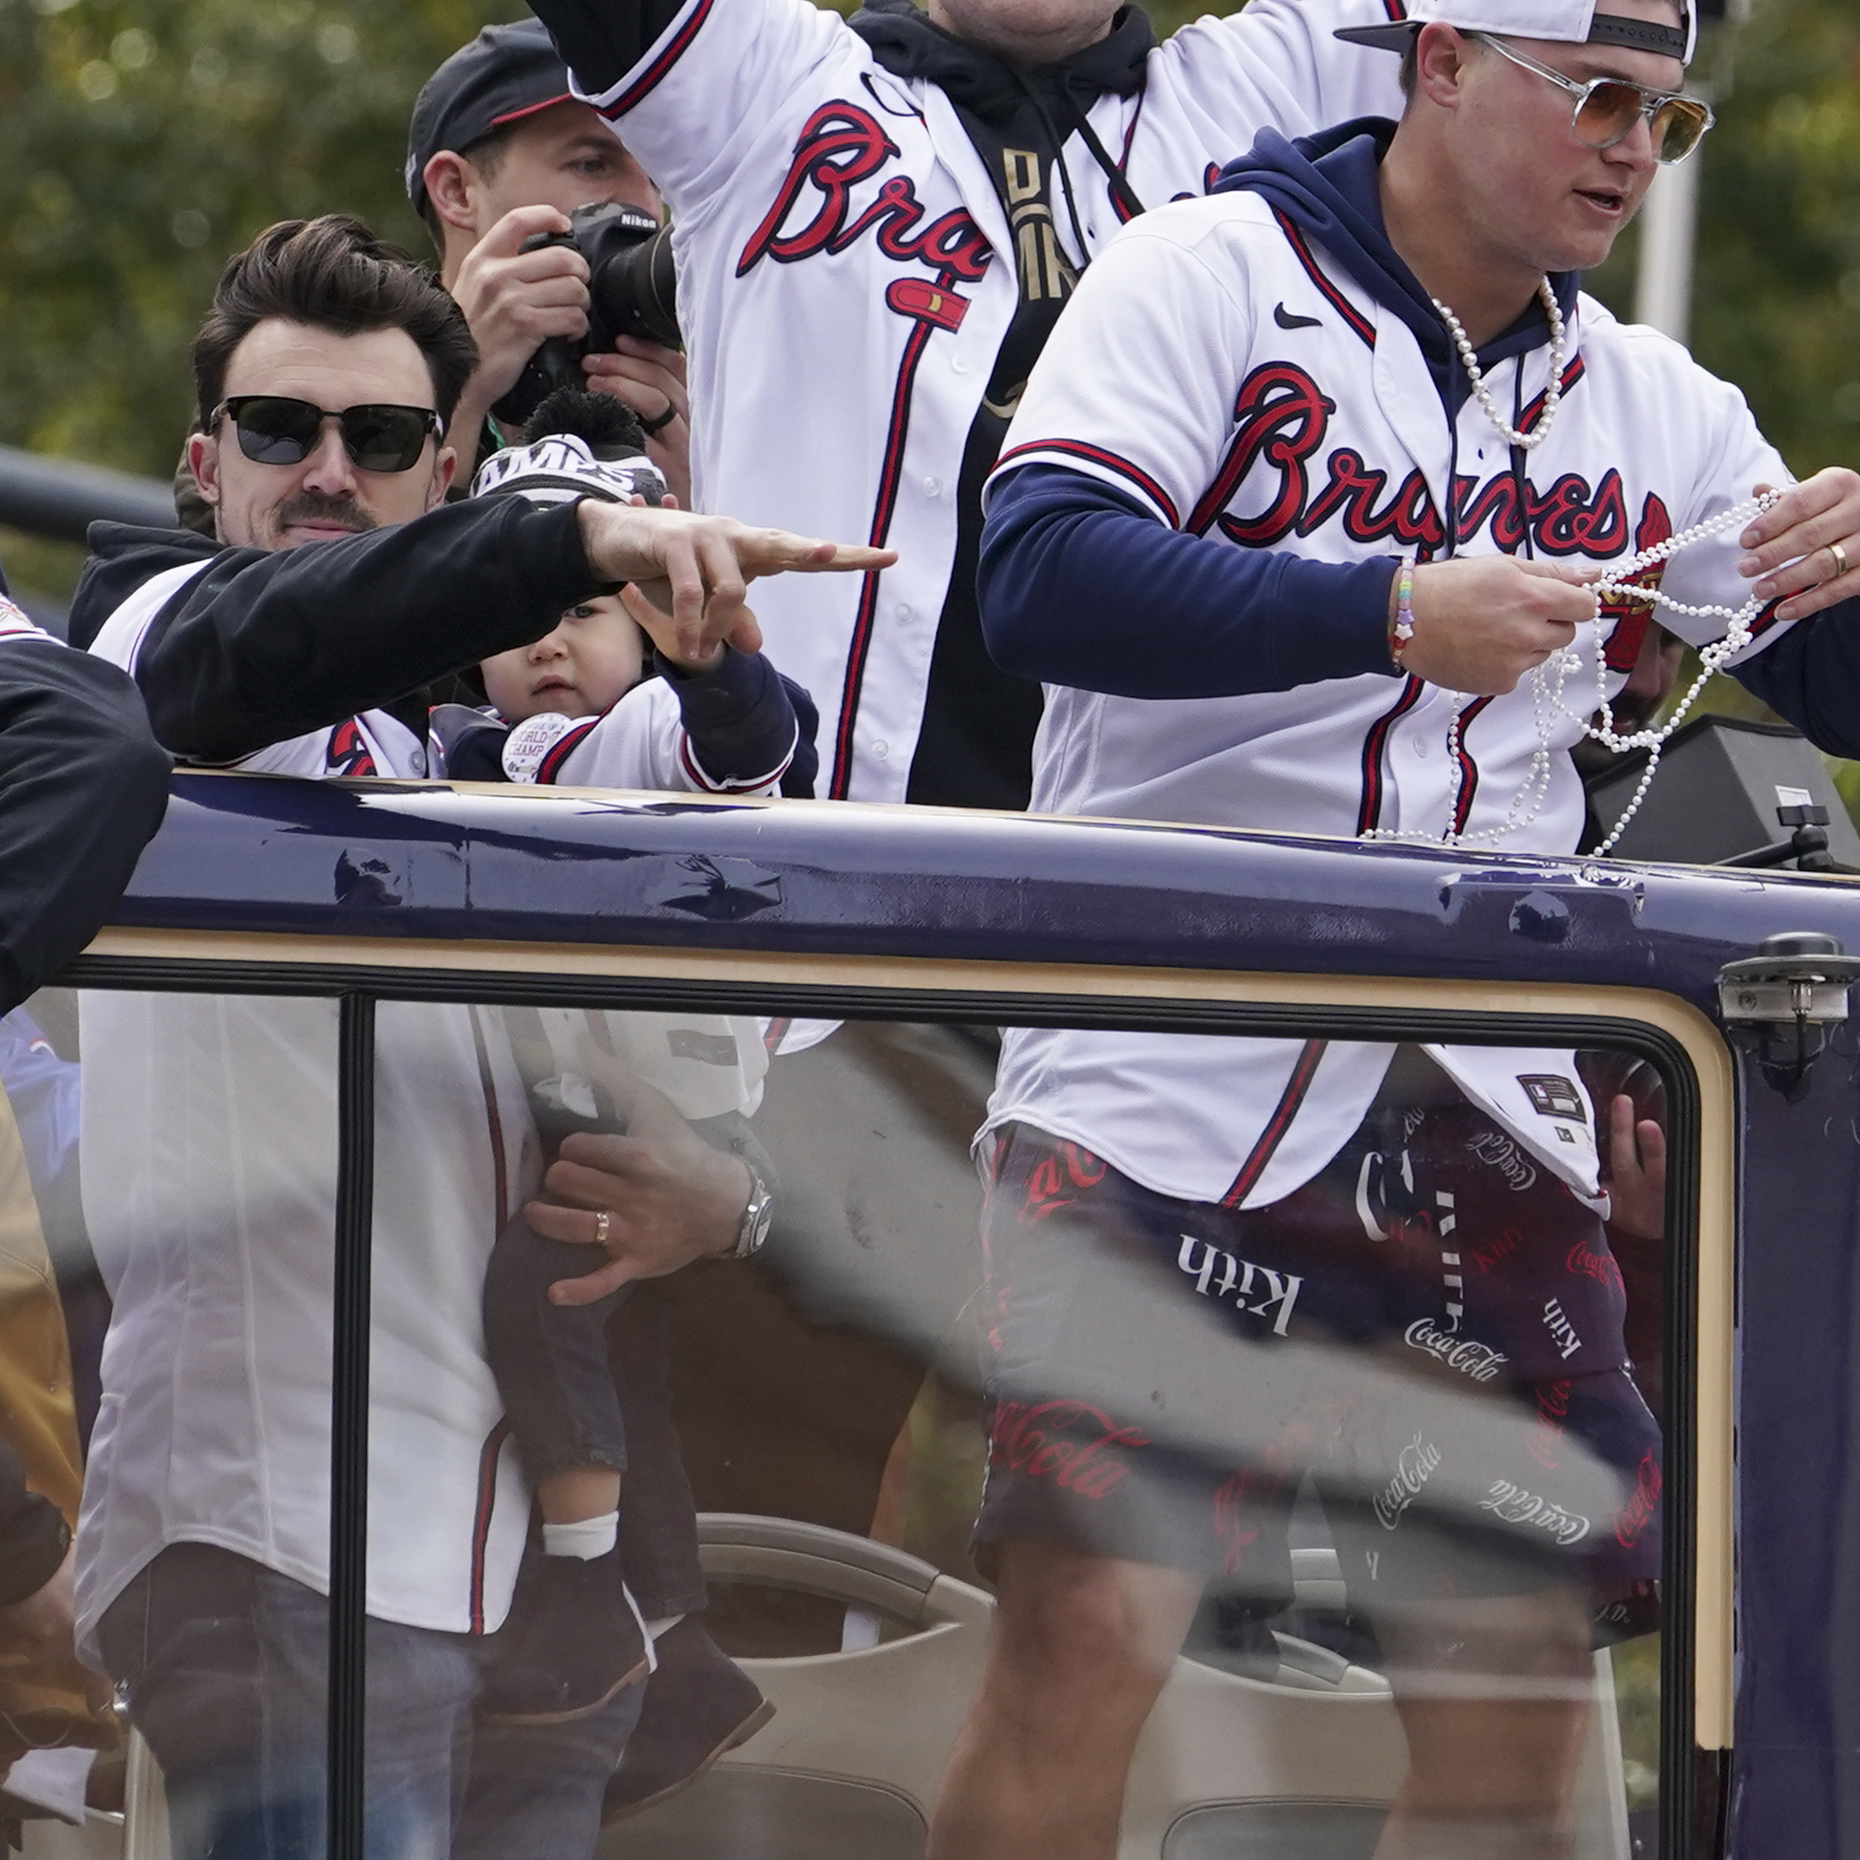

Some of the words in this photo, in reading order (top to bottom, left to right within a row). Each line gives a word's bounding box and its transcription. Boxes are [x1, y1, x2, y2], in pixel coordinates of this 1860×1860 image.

[621, 213, 657, 229] Nikon
[1176, 1233, 1304, 1337] Kith
[1541, 1296, 1583, 1360] Kith
